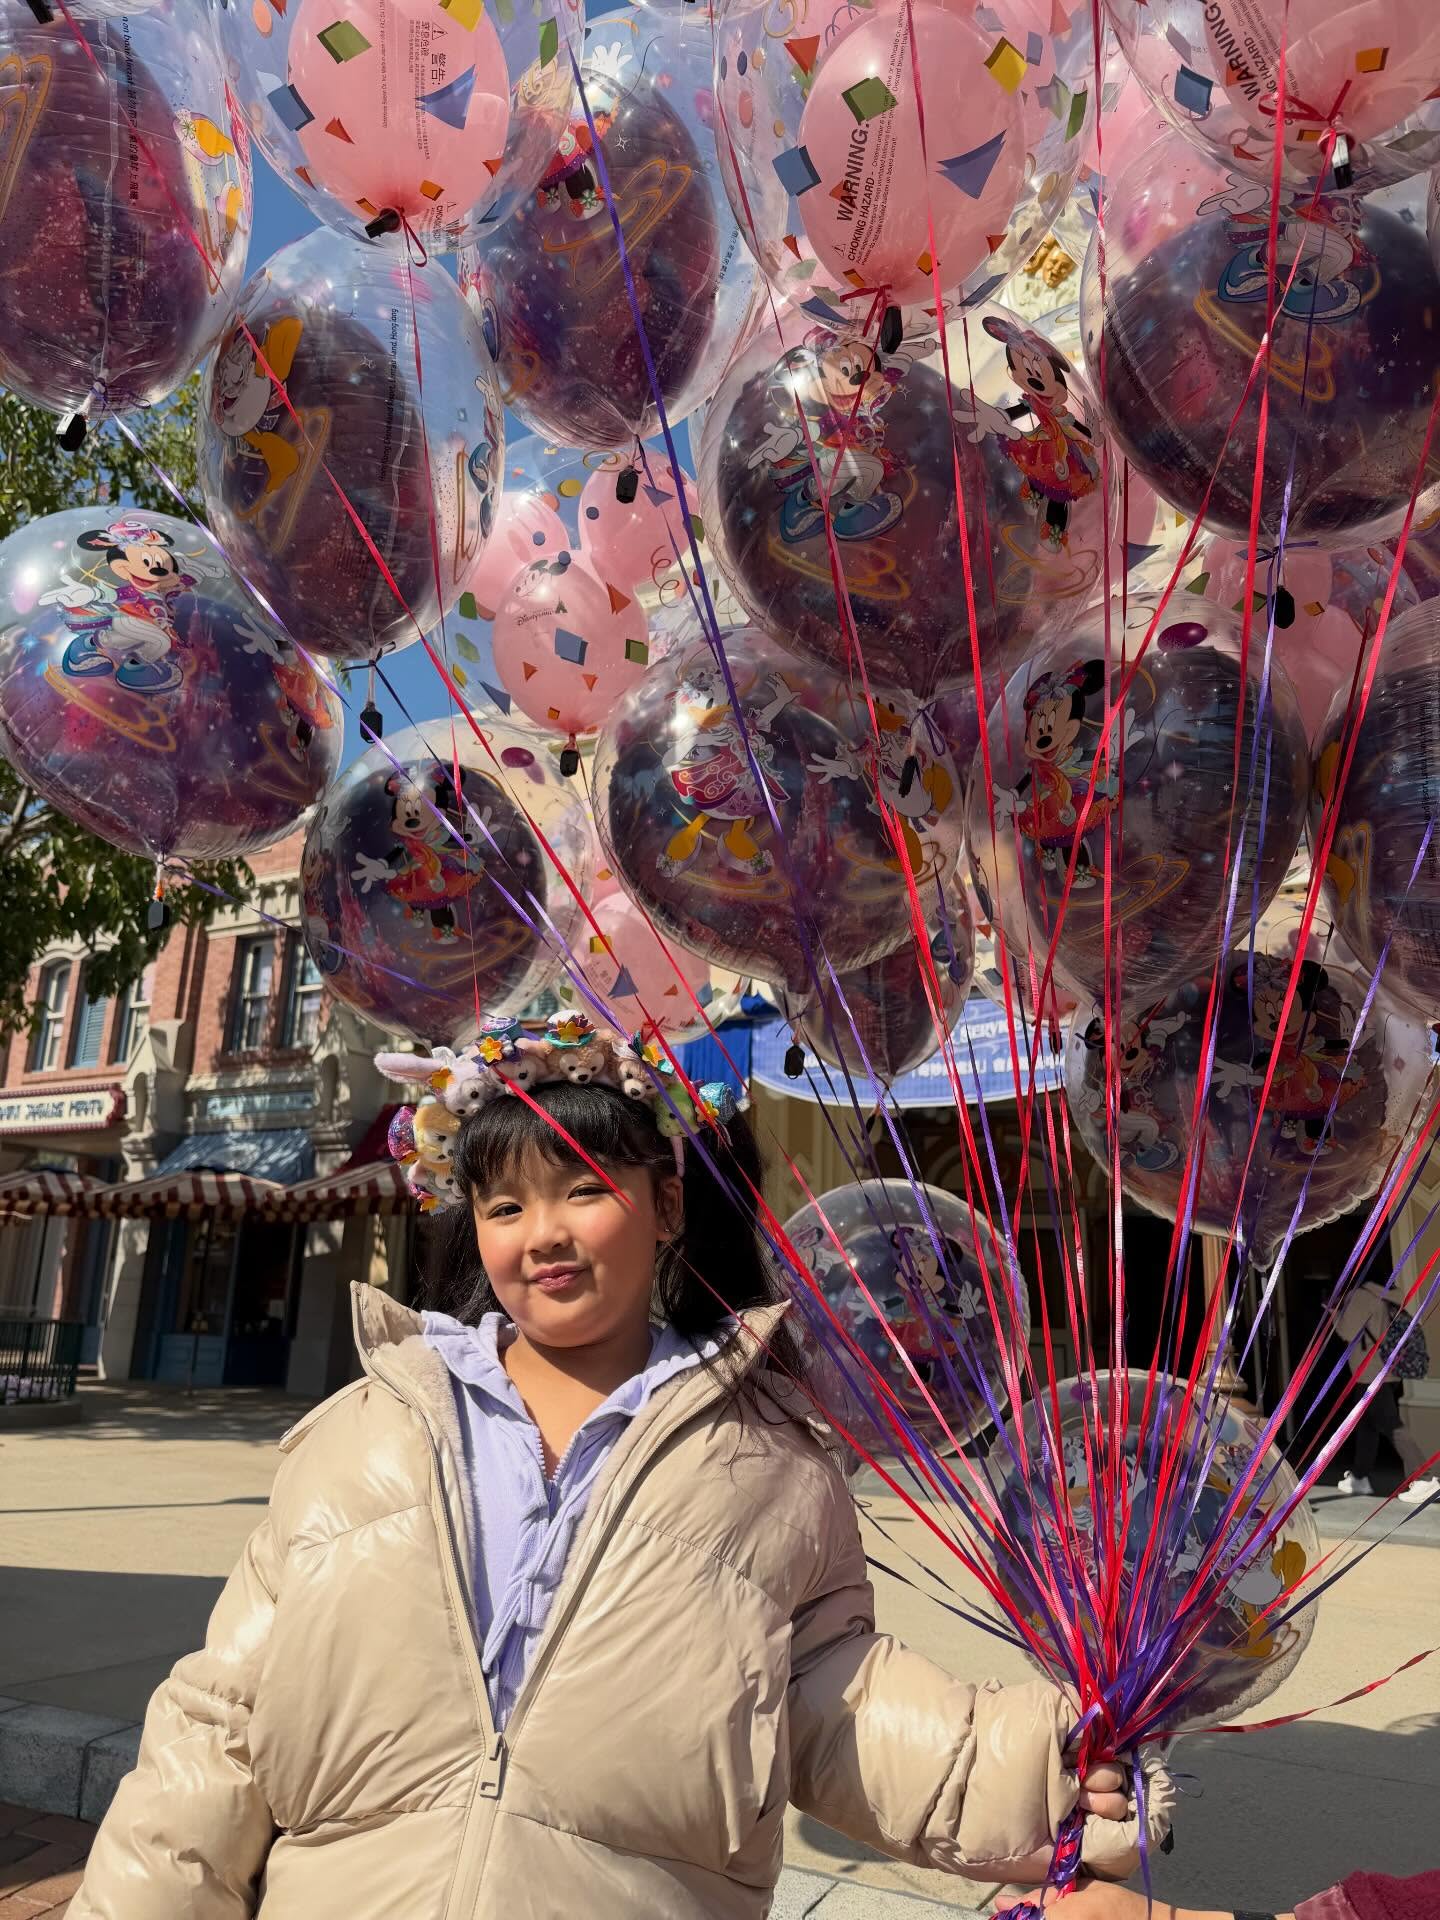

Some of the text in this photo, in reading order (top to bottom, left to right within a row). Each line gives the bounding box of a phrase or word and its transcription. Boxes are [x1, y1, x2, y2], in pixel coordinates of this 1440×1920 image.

[1244, 37, 1273, 80] HAZARD
[848, 219, 867, 261] CHOKING
[860, 177, 876, 219] HAZARD
[389, 321, 399, 341] Hong
